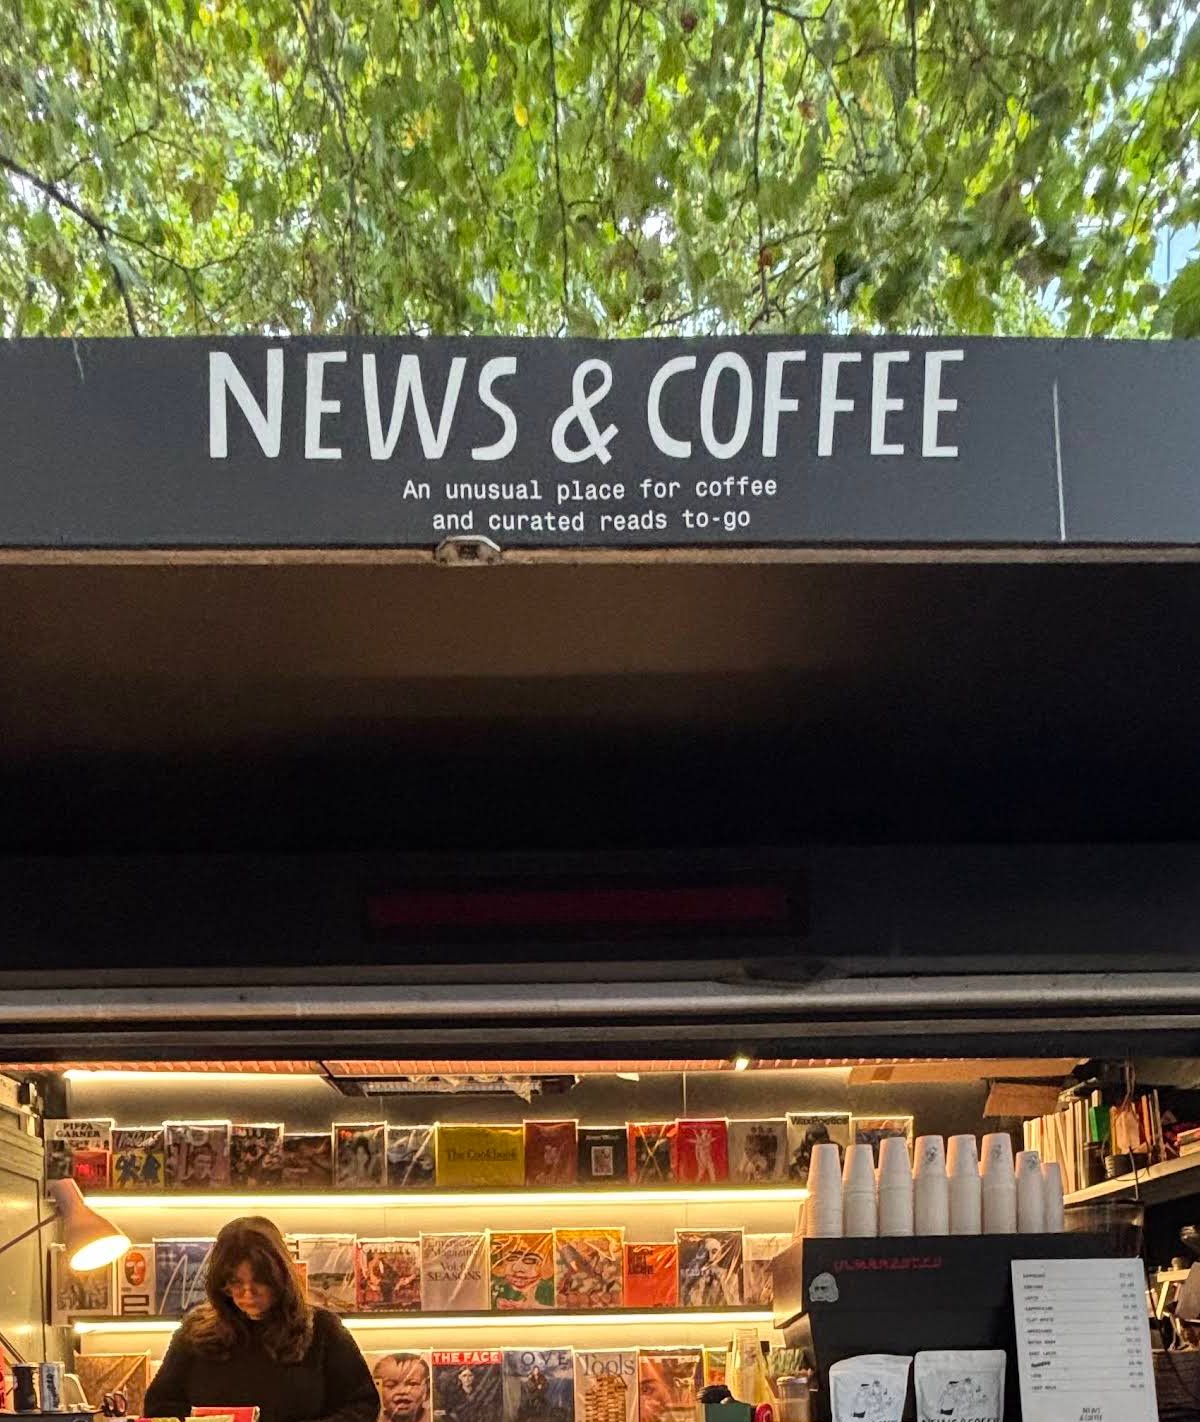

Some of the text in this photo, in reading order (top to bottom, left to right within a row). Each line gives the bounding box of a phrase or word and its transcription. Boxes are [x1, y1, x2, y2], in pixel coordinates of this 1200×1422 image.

[209, 349, 966, 465] NEWS & COFFEE
[402, 476, 778, 505] An unusual place for coffee
[432, 508, 751, 532] and curated reads to-go
[56, 1130, 101, 1138] GARNER
[63, 1122, 93, 1130] PIPPA
[427, 1271, 482, 1281] SEASONS
[433, 1351, 500, 1364] THE FACE
[579, 1353, 637, 1377] Tools
